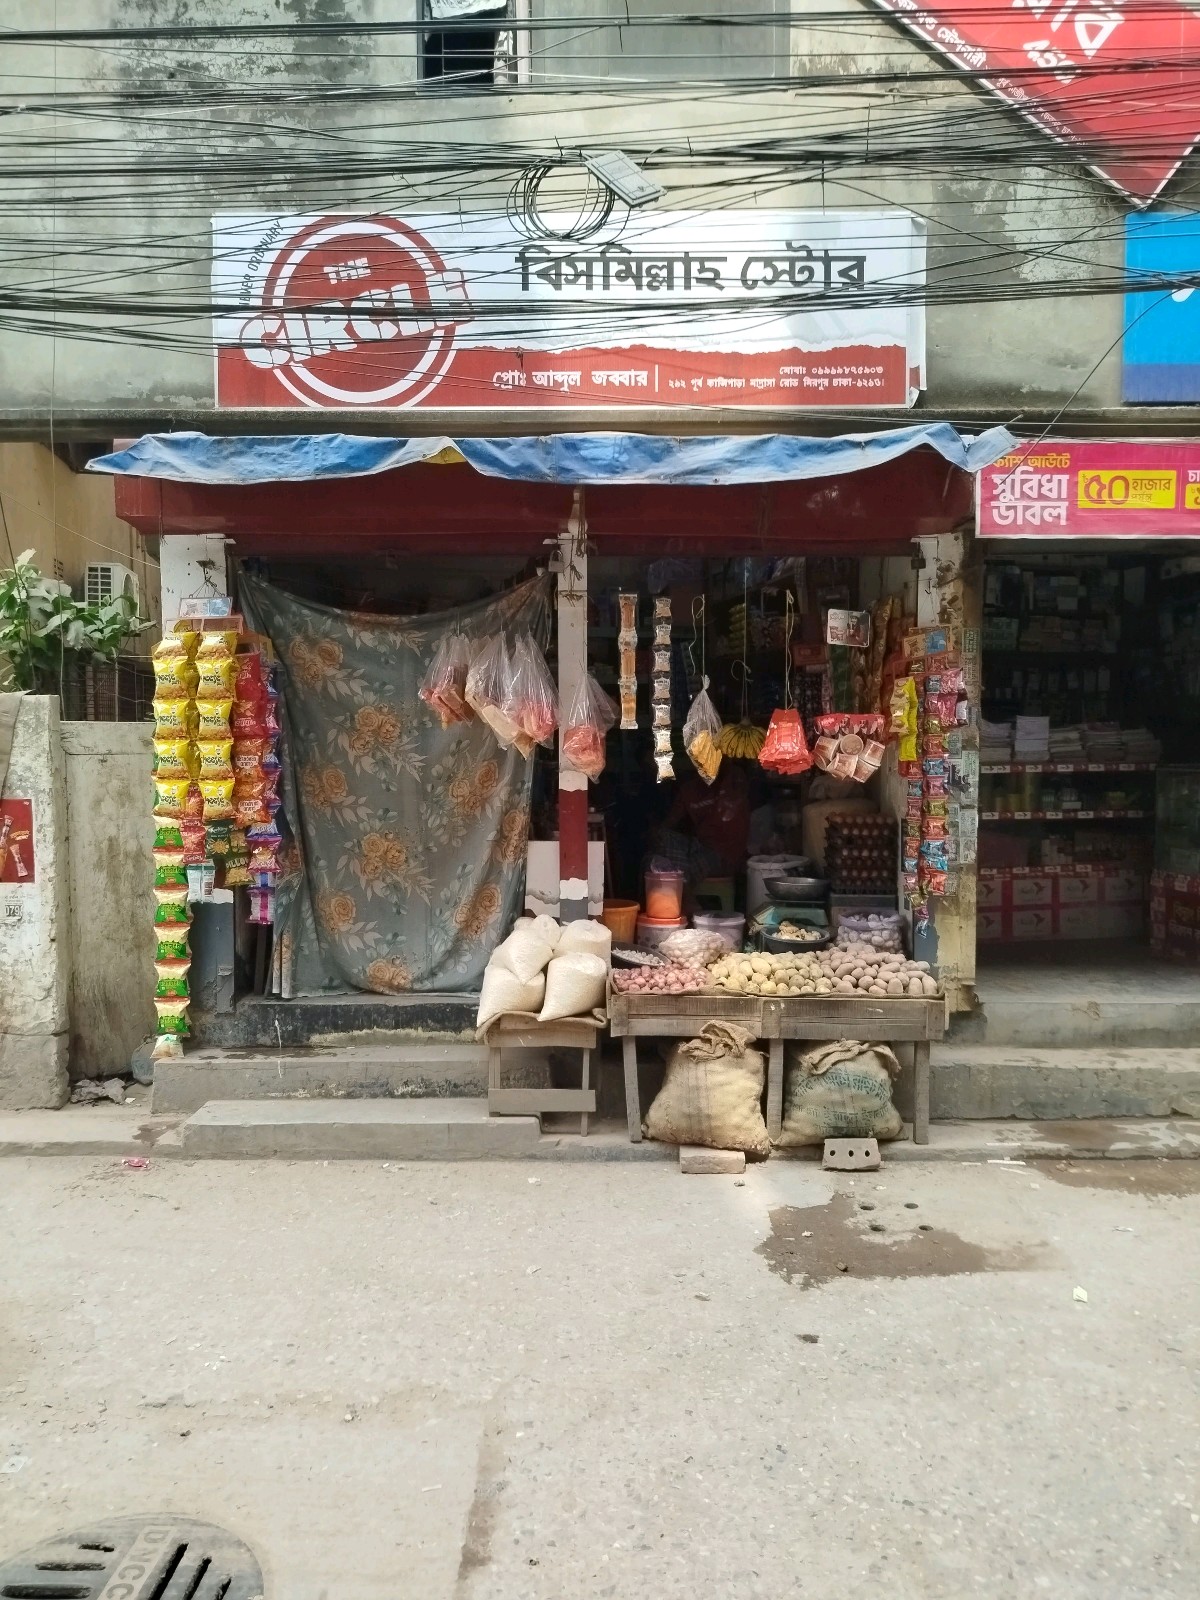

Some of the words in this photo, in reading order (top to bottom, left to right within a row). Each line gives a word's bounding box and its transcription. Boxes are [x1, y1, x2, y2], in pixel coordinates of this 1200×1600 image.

[324, 257, 371, 284] THE
[514, 243, 728, 292] বিসমিল্লাহ
[741, 240, 867, 291] স্টোর
[532, 369, 582, 394] আব্দুল
[591, 368, 649, 387] জব্বার
[690, 375, 704, 392] পূর্ব
[803, 375, 830, 391] মিরপুর
[1027, 452, 1071, 468] আউটে
[991, 465, 1070, 503] সুবিধা
[1131, 478, 1173, 491] হাজার
[990, 501, 1069, 526] ডাবল
